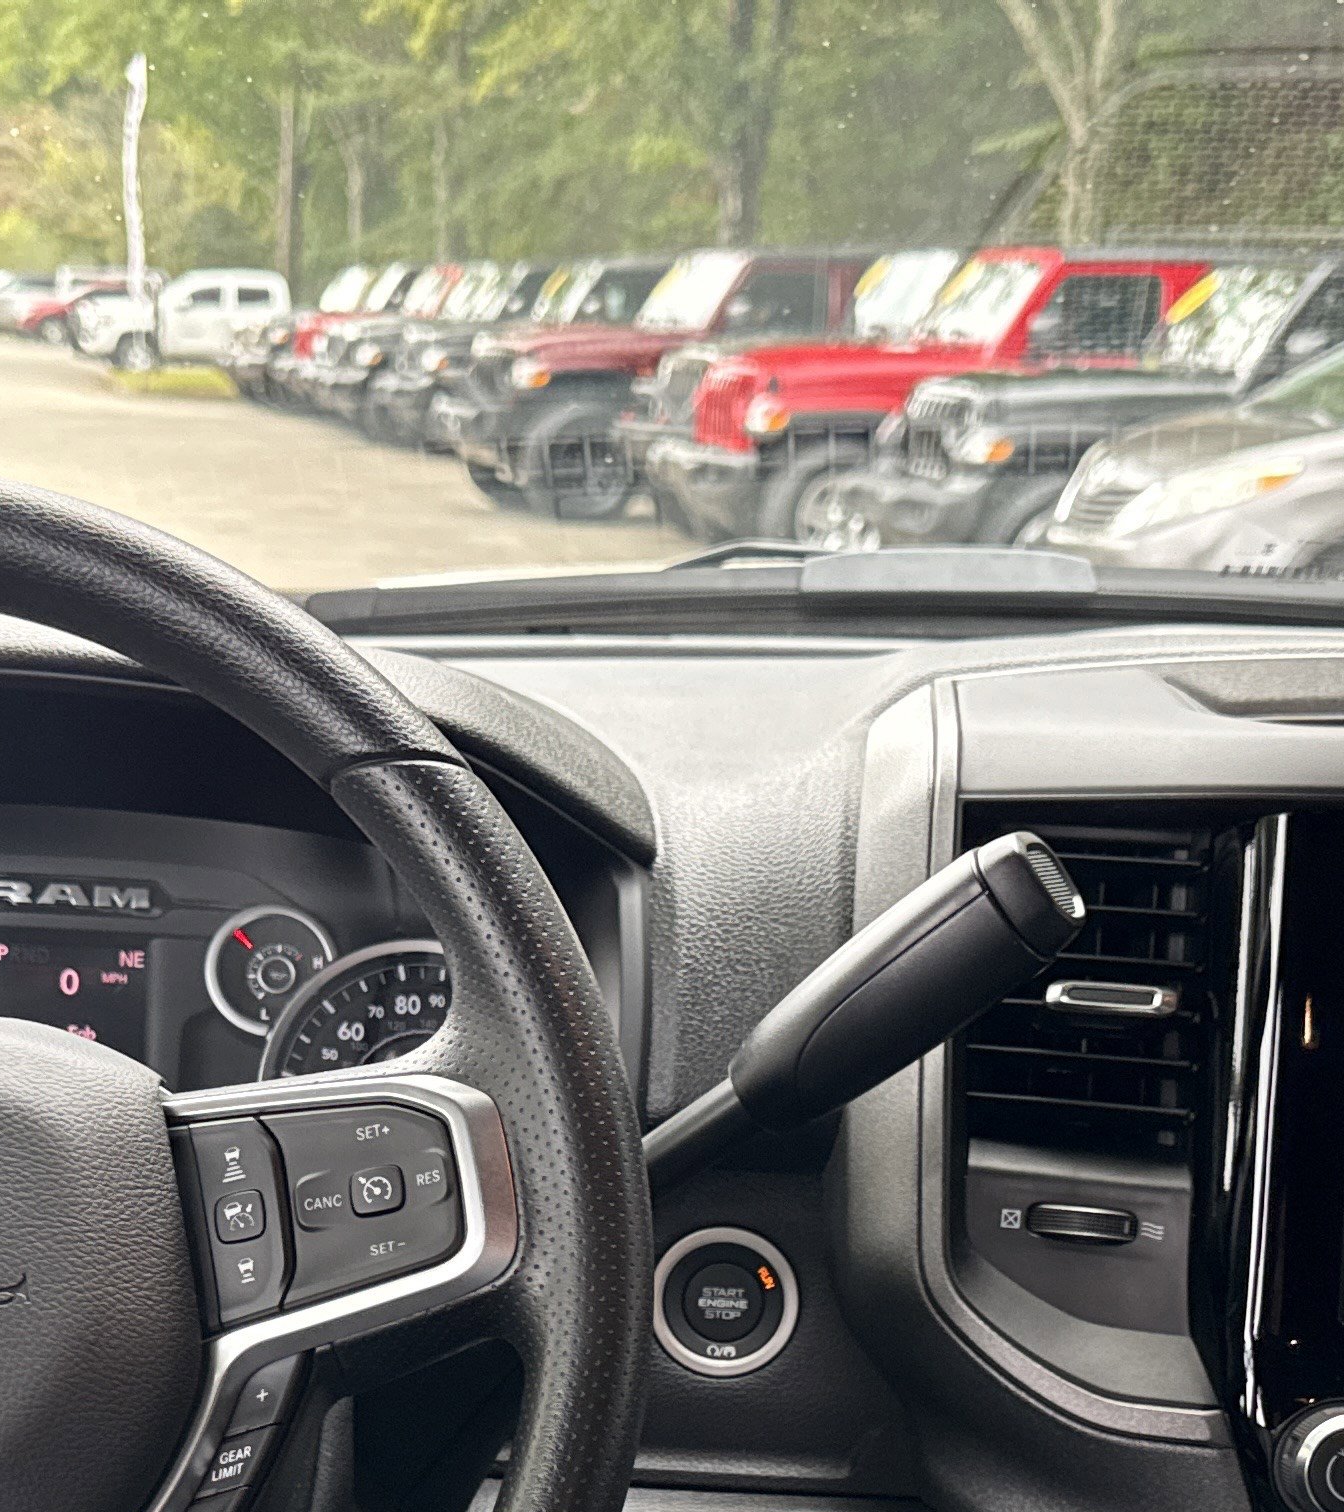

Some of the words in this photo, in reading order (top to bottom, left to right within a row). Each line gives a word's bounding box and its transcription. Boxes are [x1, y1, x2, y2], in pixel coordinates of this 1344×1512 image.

[118, 949, 146, 969] NE
[311, 954, 324, 970] H
[59, 967, 80, 995] 0
[101, 971, 129, 986] MPH
[394, 994, 422, 1016] 80
[428, 993, 446, 1009] 90
[260, 1006, 270, 1021] L
[367, 1004, 385, 1020] 70
[336, 1021, 365, 1042] 60
[320, 1046, 339, 1062] 50
[416, 1169, 441, 1188] RES
[303, 1193, 344, 1213] CANC
[701, 1286, 746, 1298] START
[697, 1297, 749, 1310] ENGINE
[703, 1309, 742, 1321] STOP
[219, 1445, 253, 1465] GEAR
[211, 1462, 245, 1483] LIMIT
